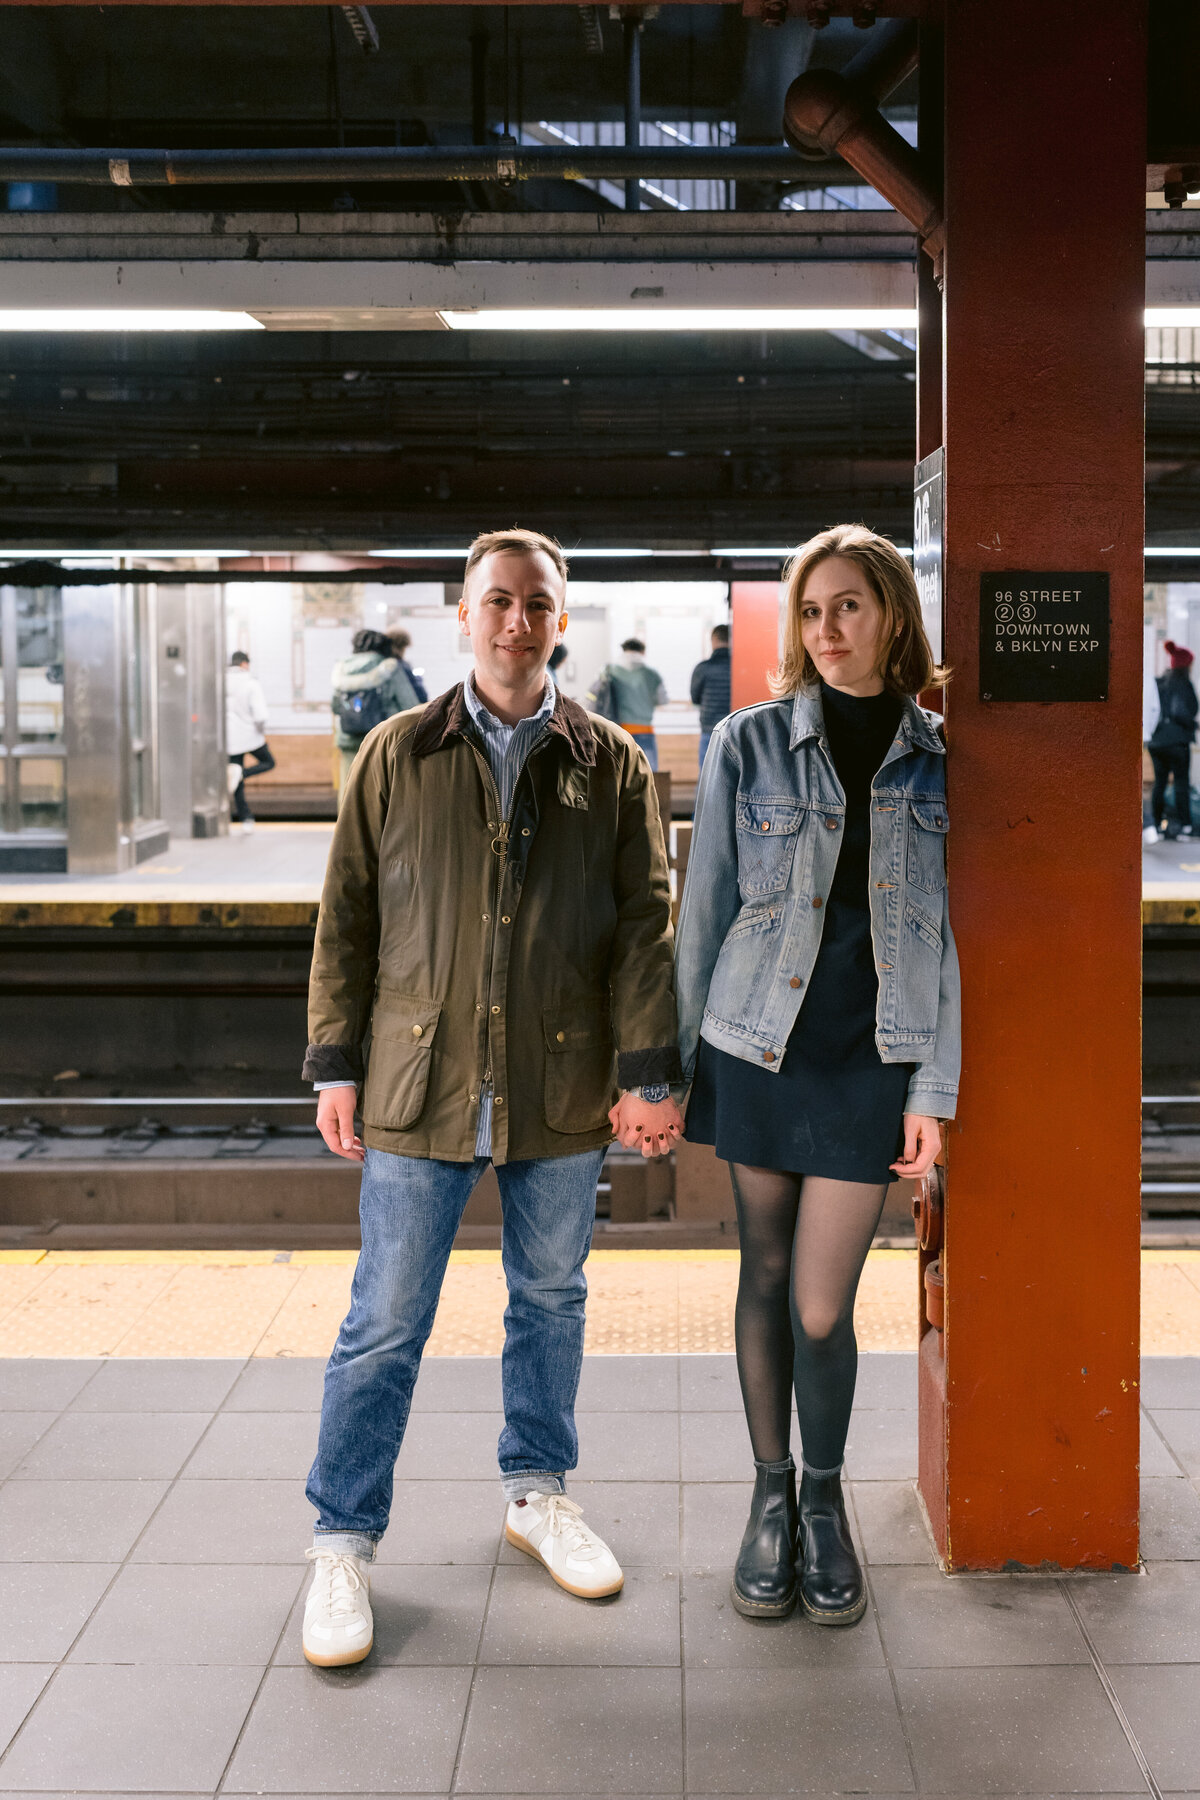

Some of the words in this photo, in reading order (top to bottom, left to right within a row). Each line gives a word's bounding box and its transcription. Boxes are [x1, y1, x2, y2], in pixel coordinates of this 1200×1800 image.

[914, 491, 930, 560] 96
[995, 591, 1012, 602] 96
[1019, 590, 1082, 602] STREET
[995, 624, 1090, 635] DOWNTOWN
[995, 641, 1004, 652] &
[1011, 641, 1062, 652] BKLYN
[1068, 641, 1099, 652] EXP
